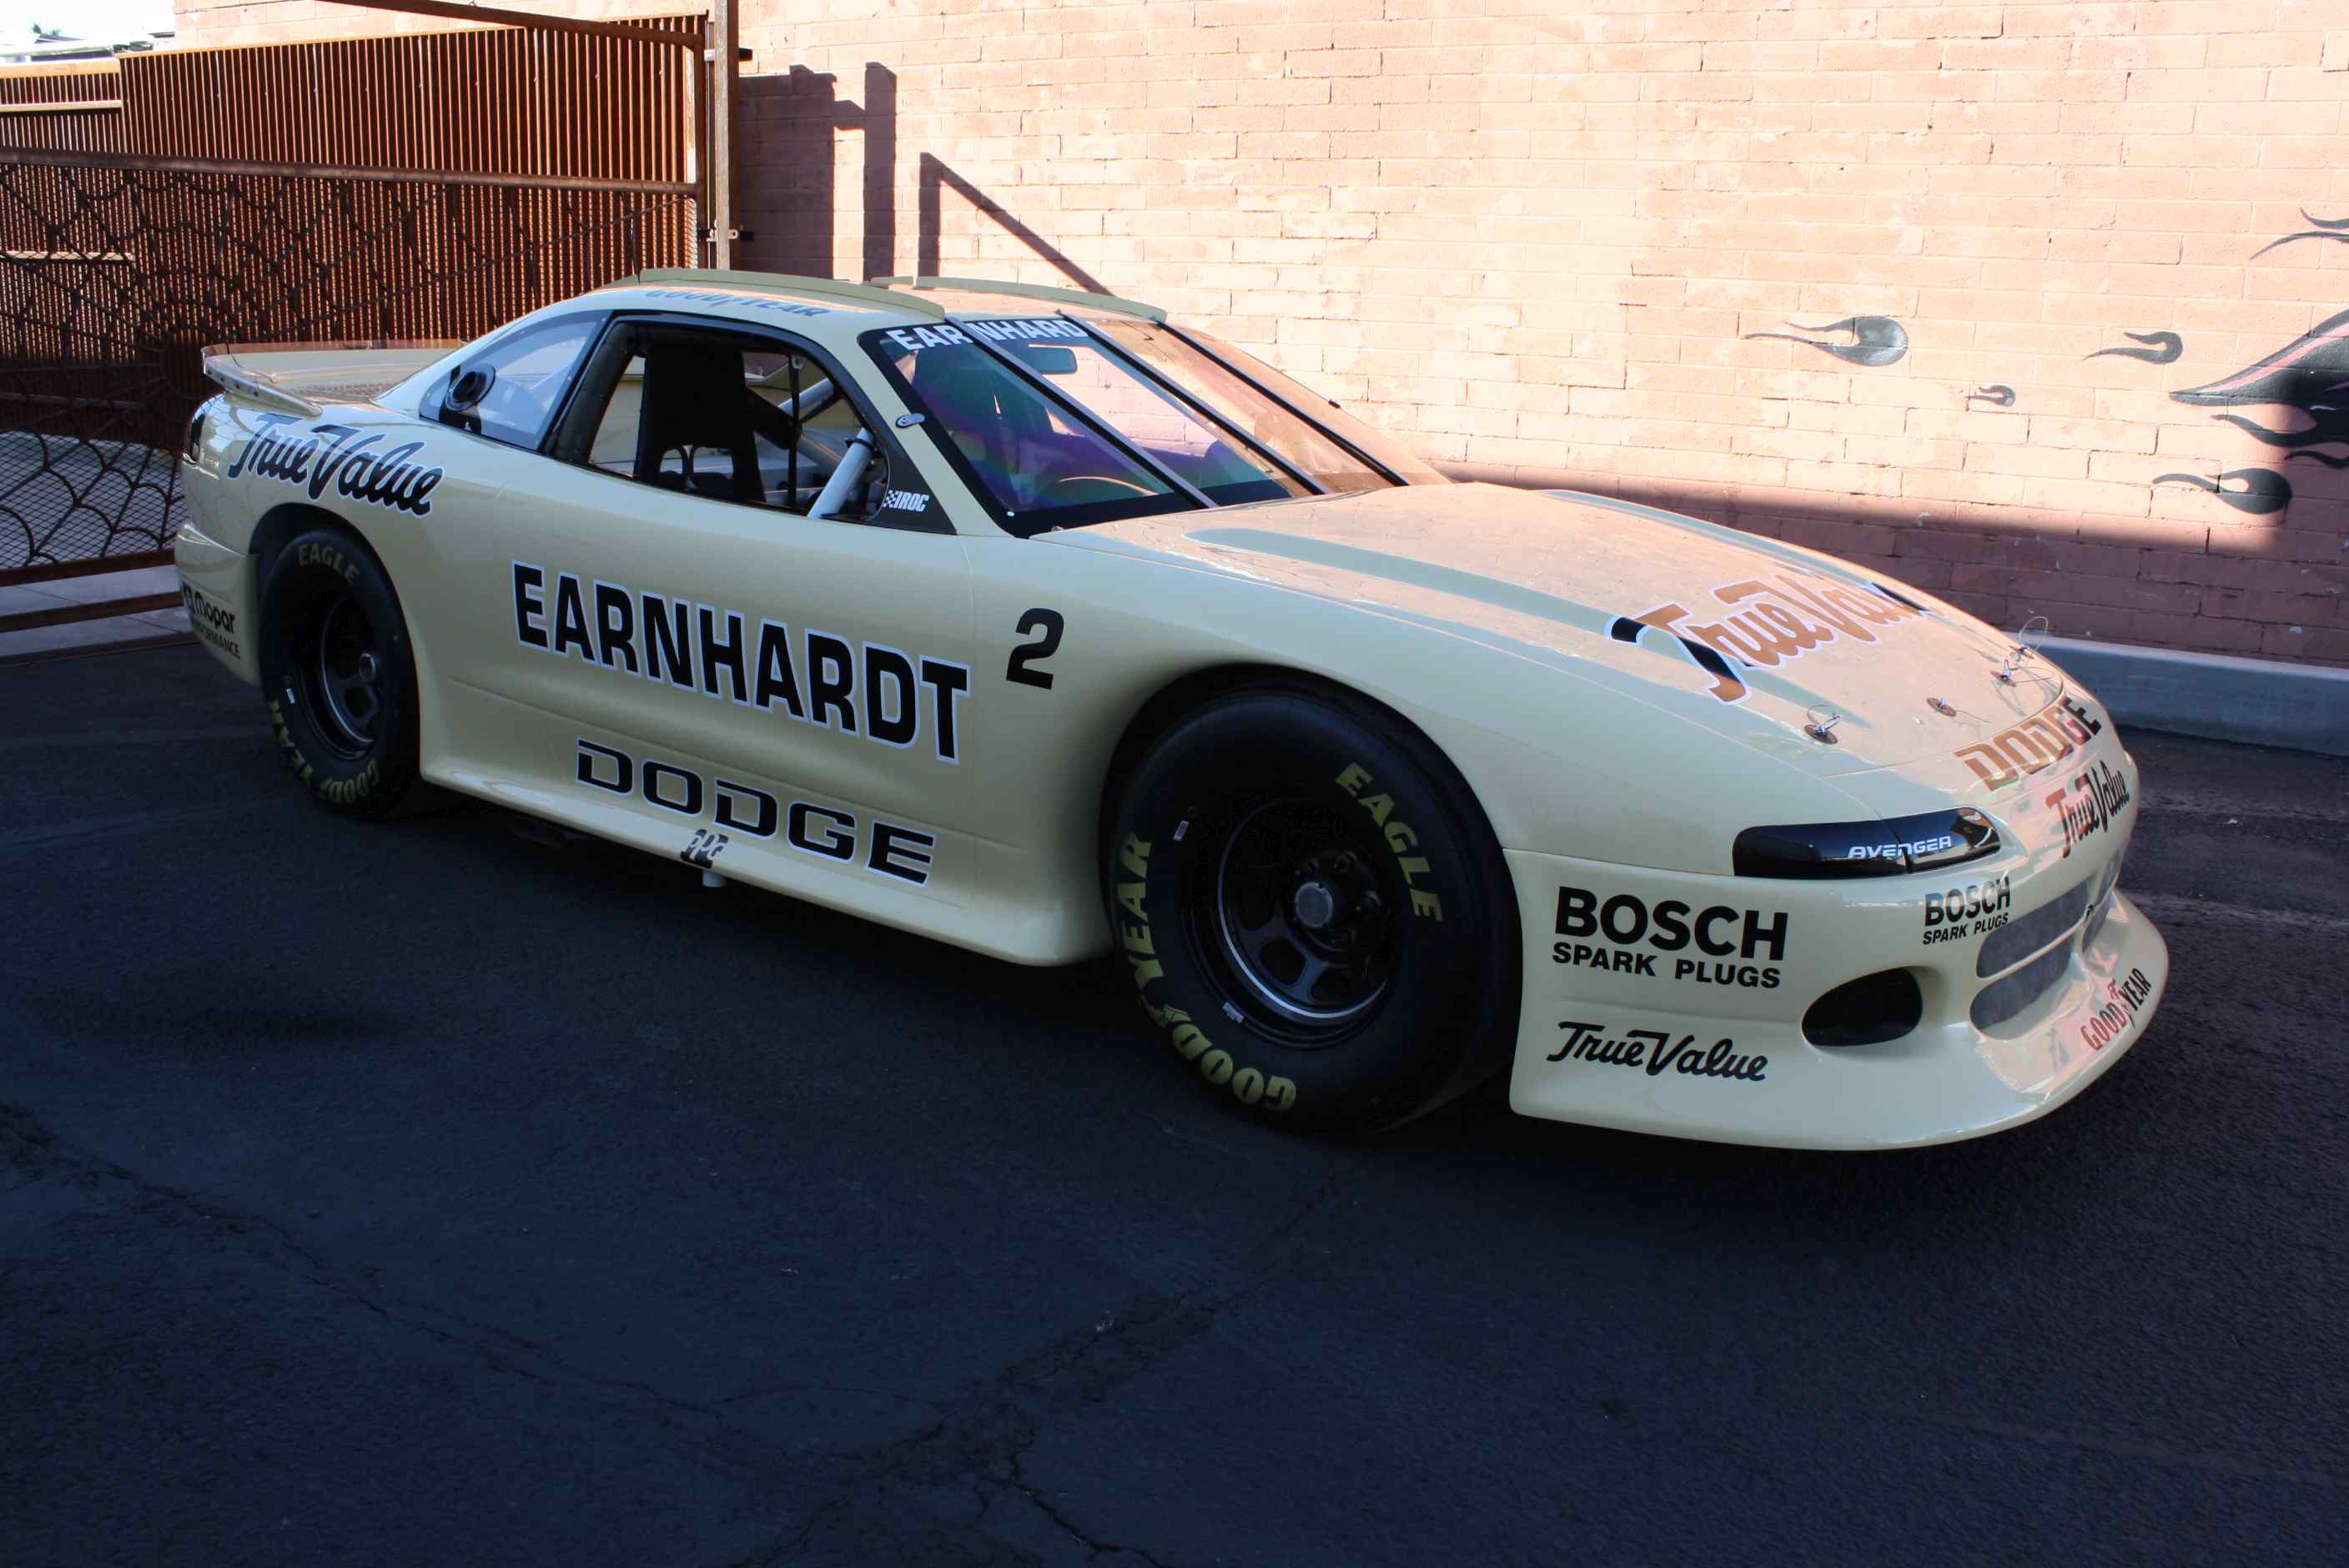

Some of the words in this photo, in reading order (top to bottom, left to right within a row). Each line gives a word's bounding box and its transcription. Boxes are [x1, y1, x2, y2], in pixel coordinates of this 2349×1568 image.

[886, 319, 1099, 350] EARNHARD
[893, 490, 929, 512] IROC
[297, 543, 360, 585] EAGLE
[512, 560, 971, 765] EARNHARDT
[1006, 607, 1065, 691] 2
[1953, 696, 2103, 792] DODGE
[575, 736, 938, 887] DODGE
[1335, 761, 1444, 922] EAGLE
[1848, 835, 1952, 860] AVENGER
[1555, 886, 1788, 961] BOSCH
[1925, 876, 2010, 927] BOSCH
[1923, 923, 1969, 945] SPARK
[1974, 912, 2009, 935] PLUGS
[1552, 942, 1657, 977] SPARK
[1674, 958, 1782, 989] PLUGS
